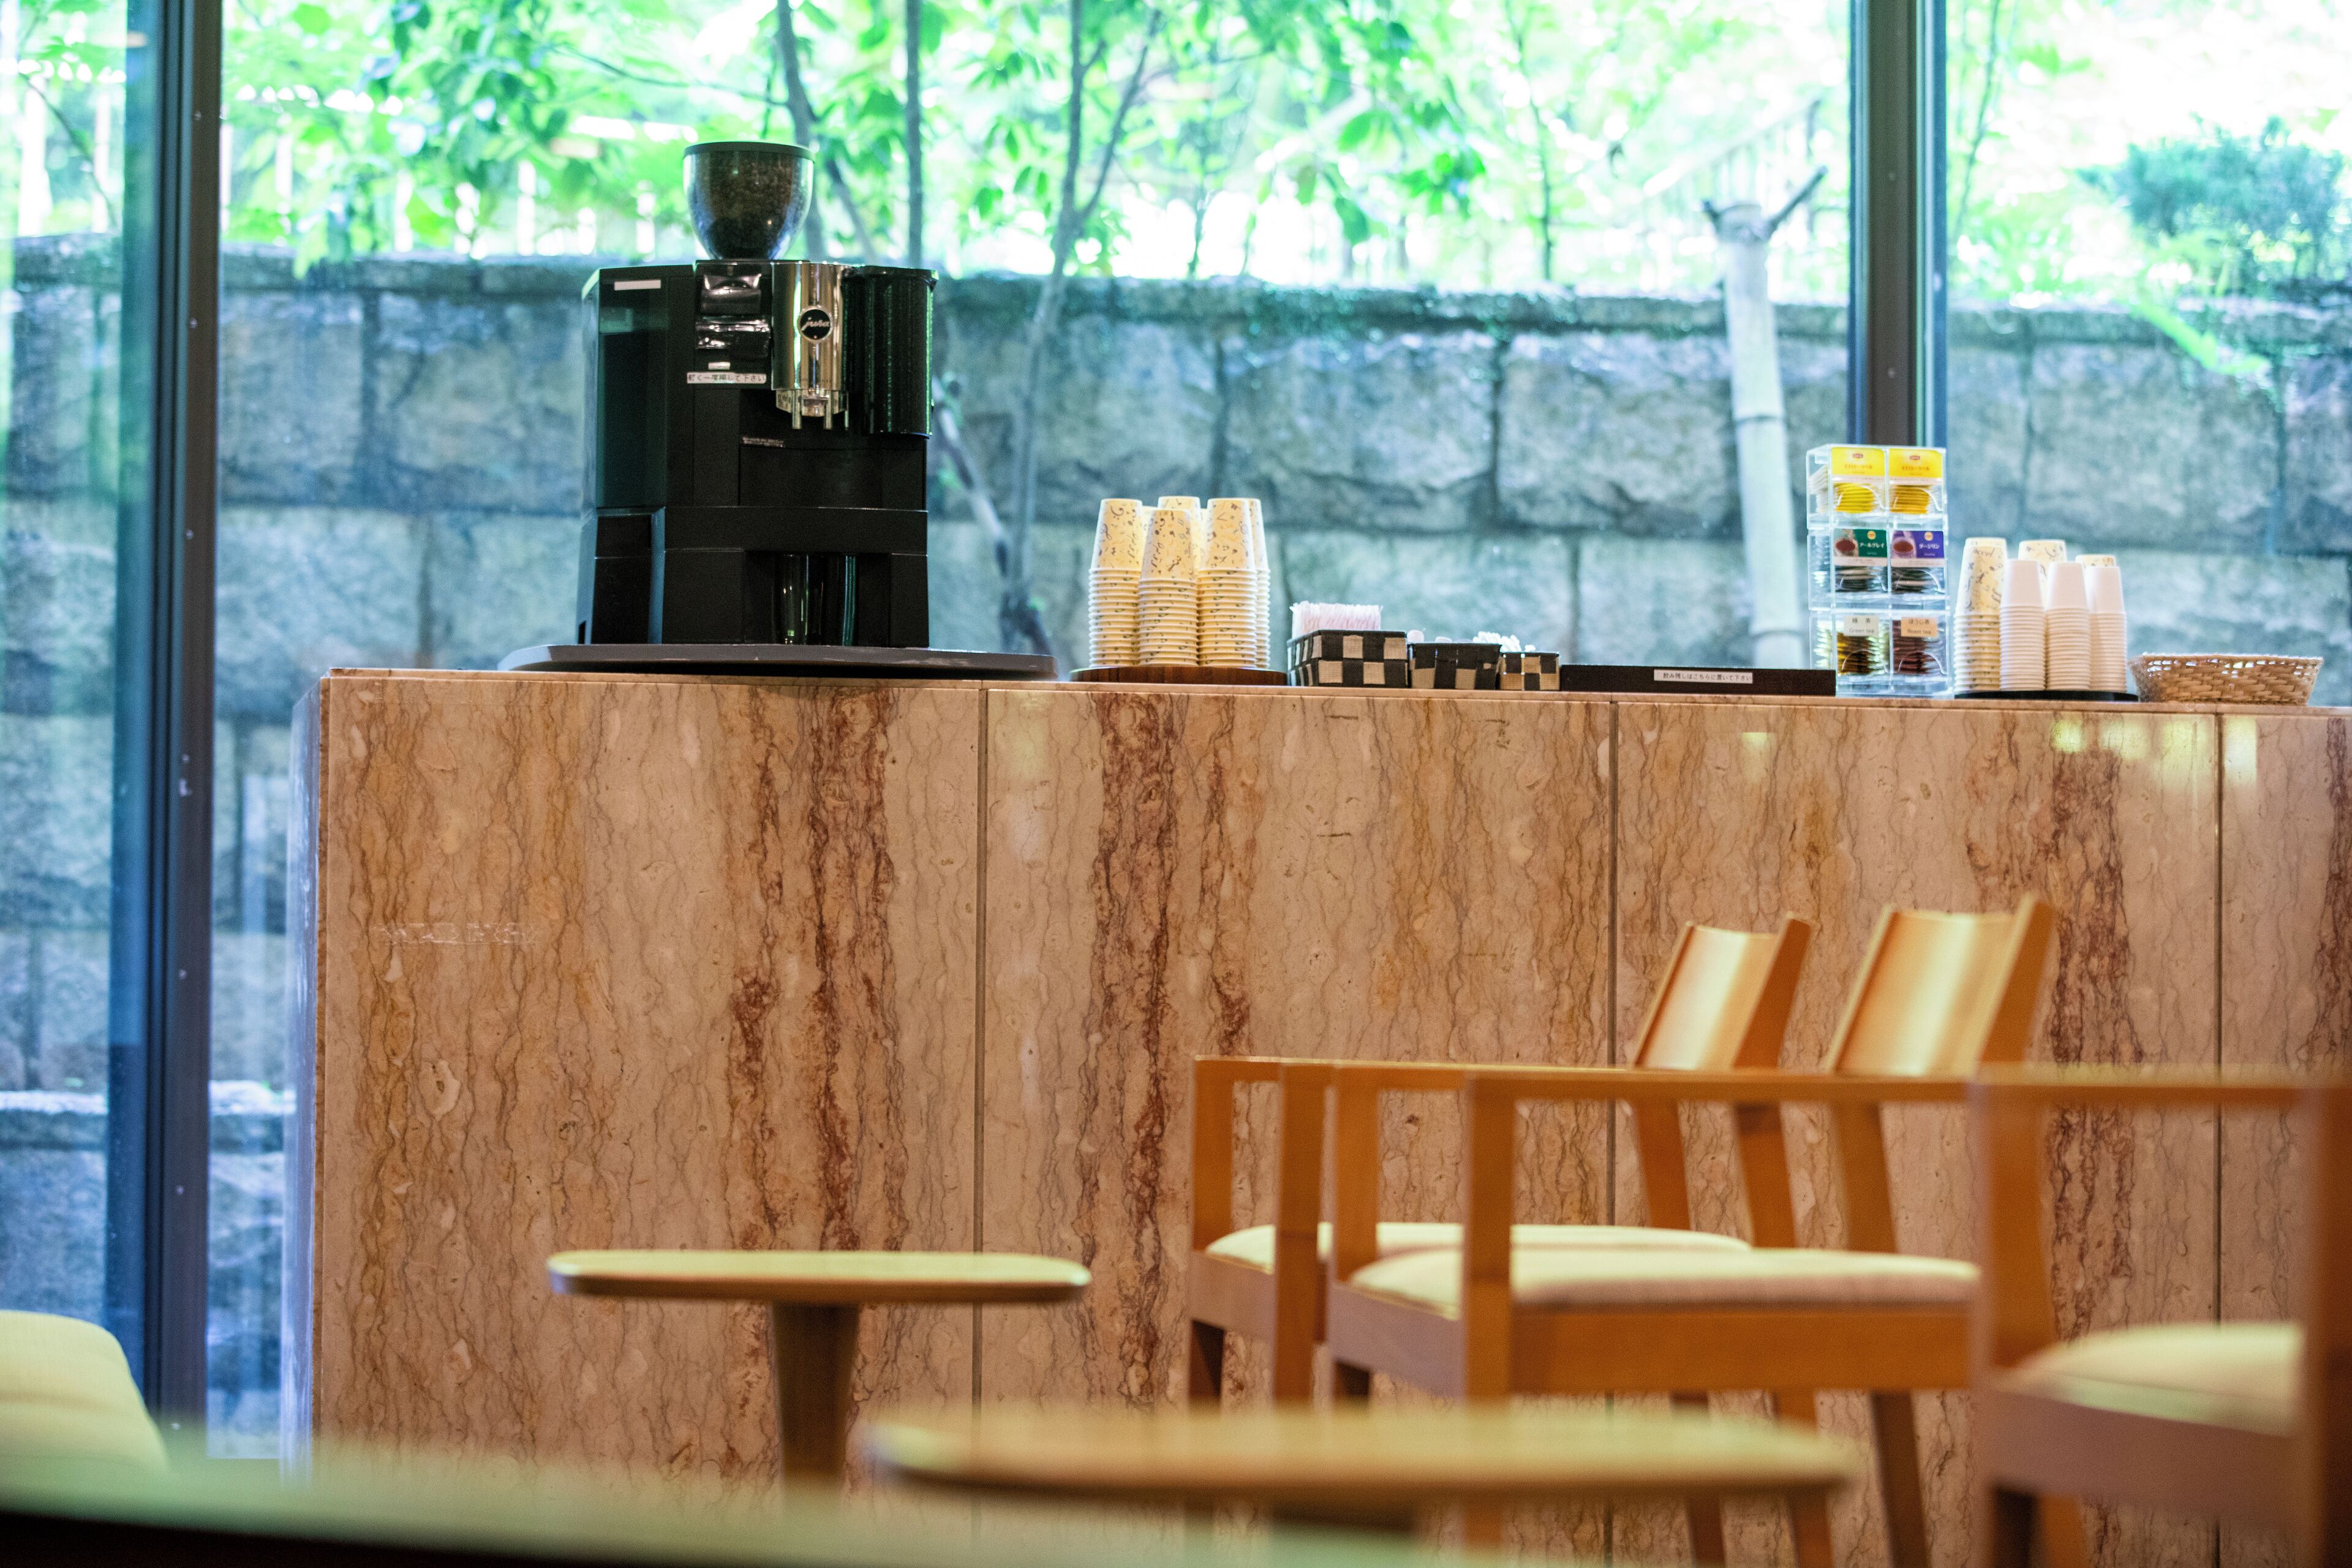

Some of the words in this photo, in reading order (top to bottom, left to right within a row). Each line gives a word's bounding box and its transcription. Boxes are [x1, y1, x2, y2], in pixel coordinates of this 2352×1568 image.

[1663, 673, 1751, 681] 飲み残しはこちらに置いて下さい
